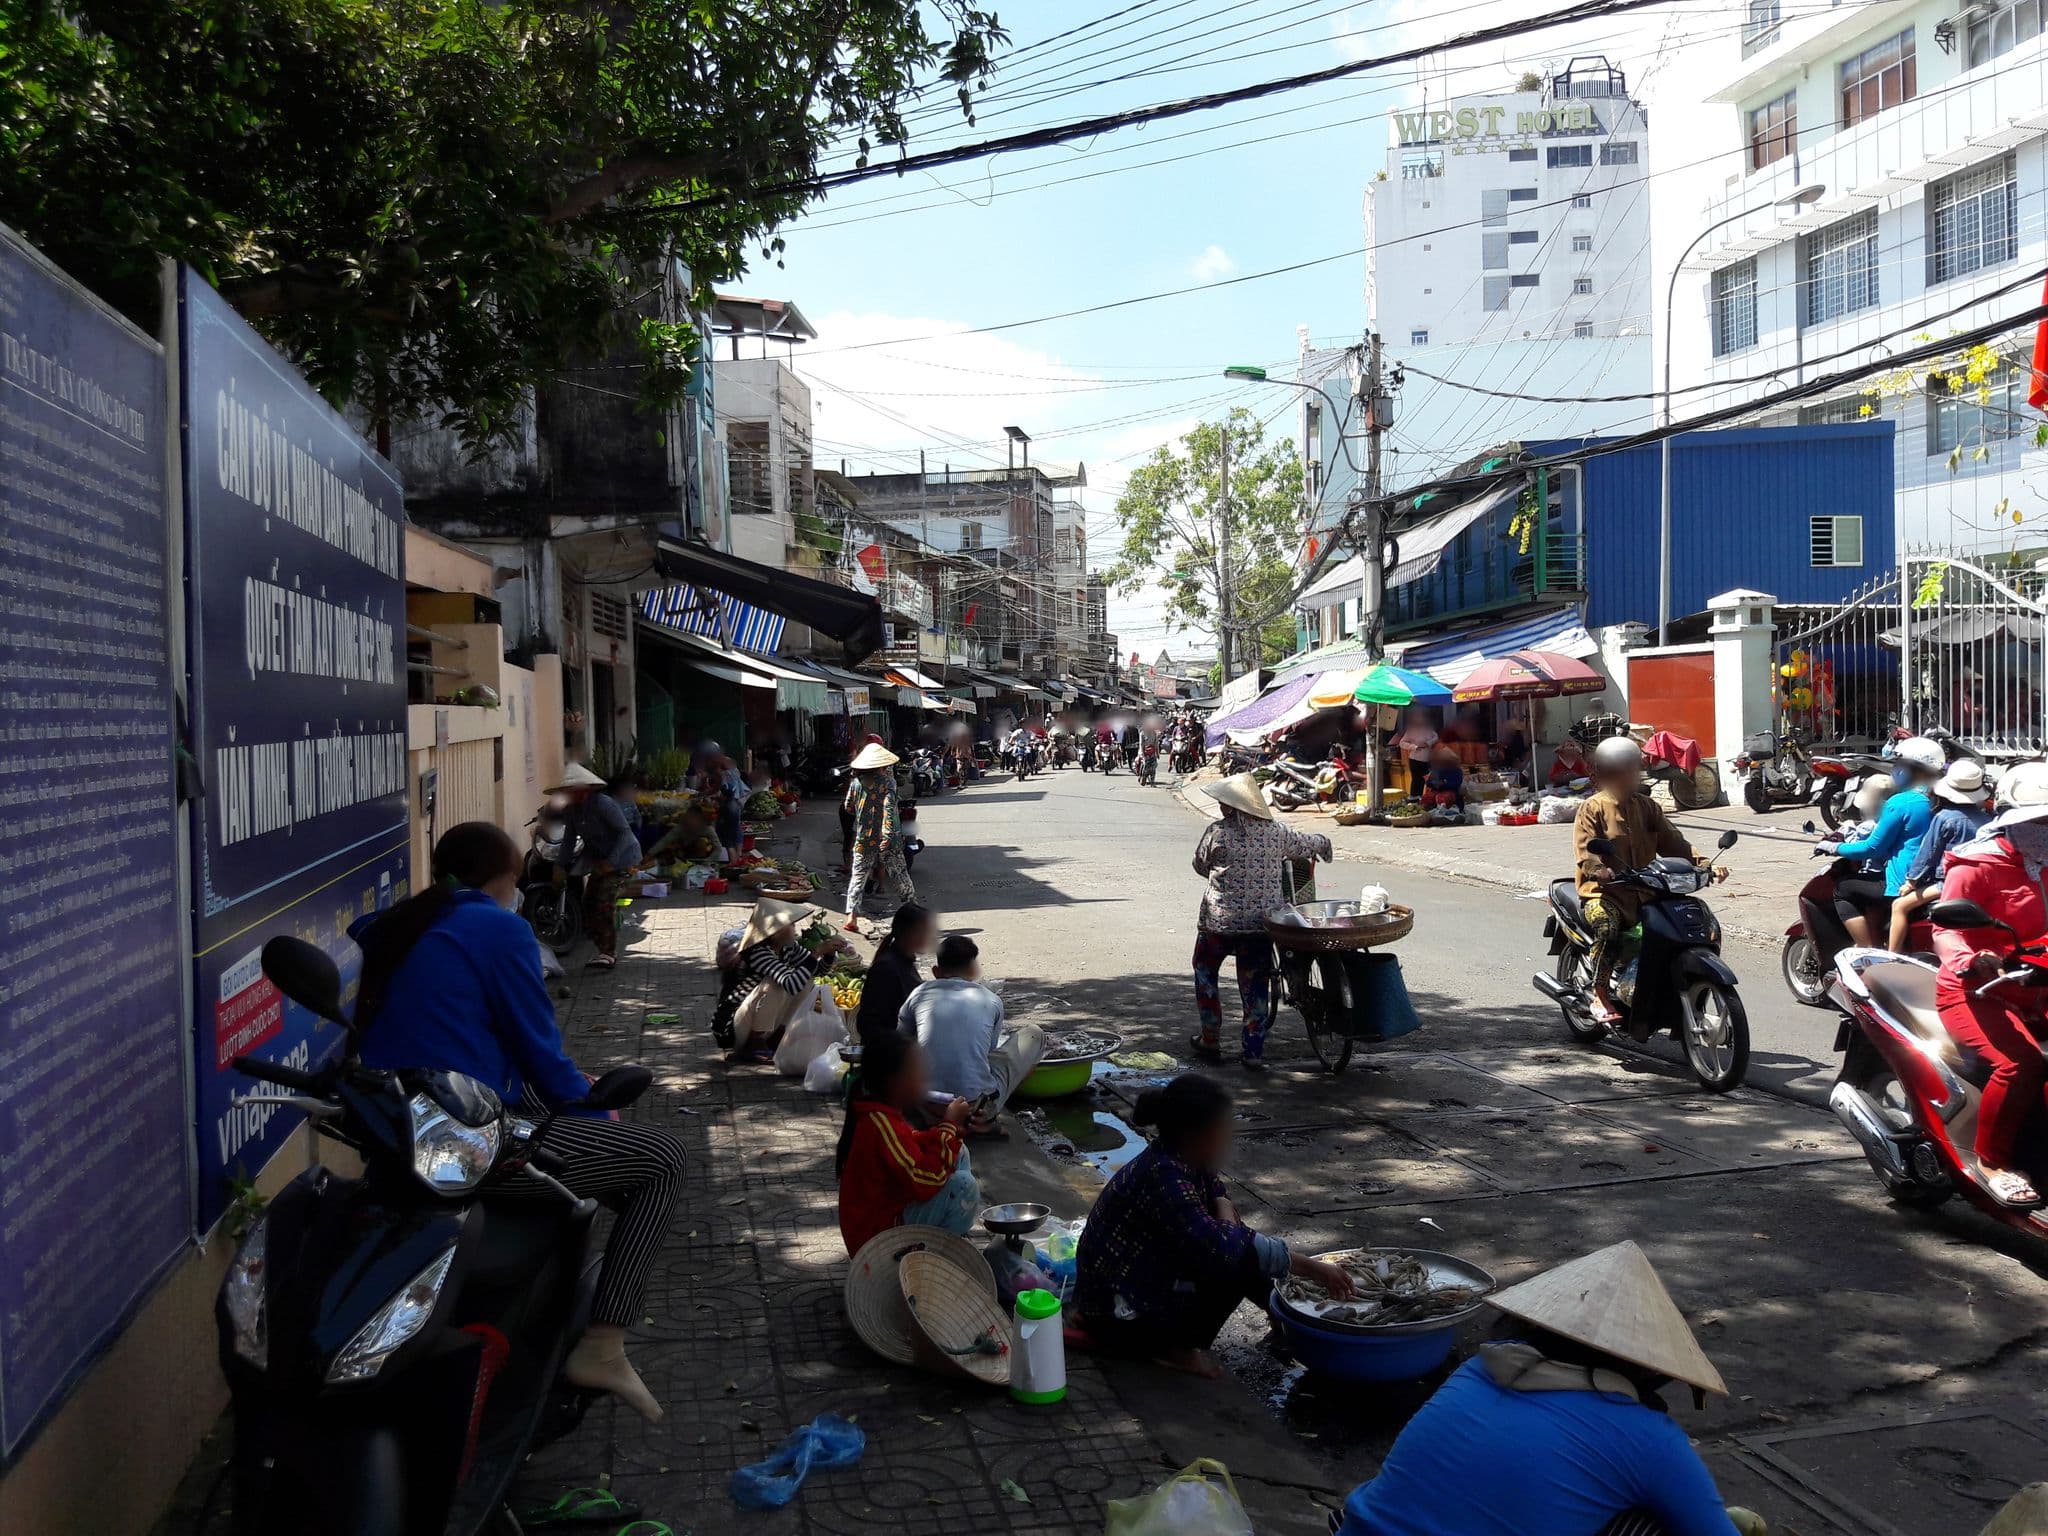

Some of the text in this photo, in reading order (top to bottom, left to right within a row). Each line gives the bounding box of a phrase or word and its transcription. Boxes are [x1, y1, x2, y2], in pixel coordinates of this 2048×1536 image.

[1393, 105, 1599, 143] WEST HOTEL
[217, 377, 250, 501] CÁN
[253, 403, 271, 532] BỘ
[272, 418, 291, 522] VÀ
[292, 439, 322, 538] NHÂN
[323, 457, 344, 550] DÂN
[344, 478, 375, 568] PHƯỜNG
[245, 557, 286, 681] QUYẾT
[287, 575, 313, 674] TÂM
[314, 585, 334, 677] XÂY
[335, 602, 359, 695] DỰNG
[359, 595, 375, 682] NẾP
[375, 600, 394, 684] SỐNG
[217, 725, 251, 847] VĂN
[253, 742, 293, 837] MINH,
[294, 722, 316, 823] MÔI
[317, 718, 354, 814] TRƯỜNG
[354, 720, 371, 802] VĂN
